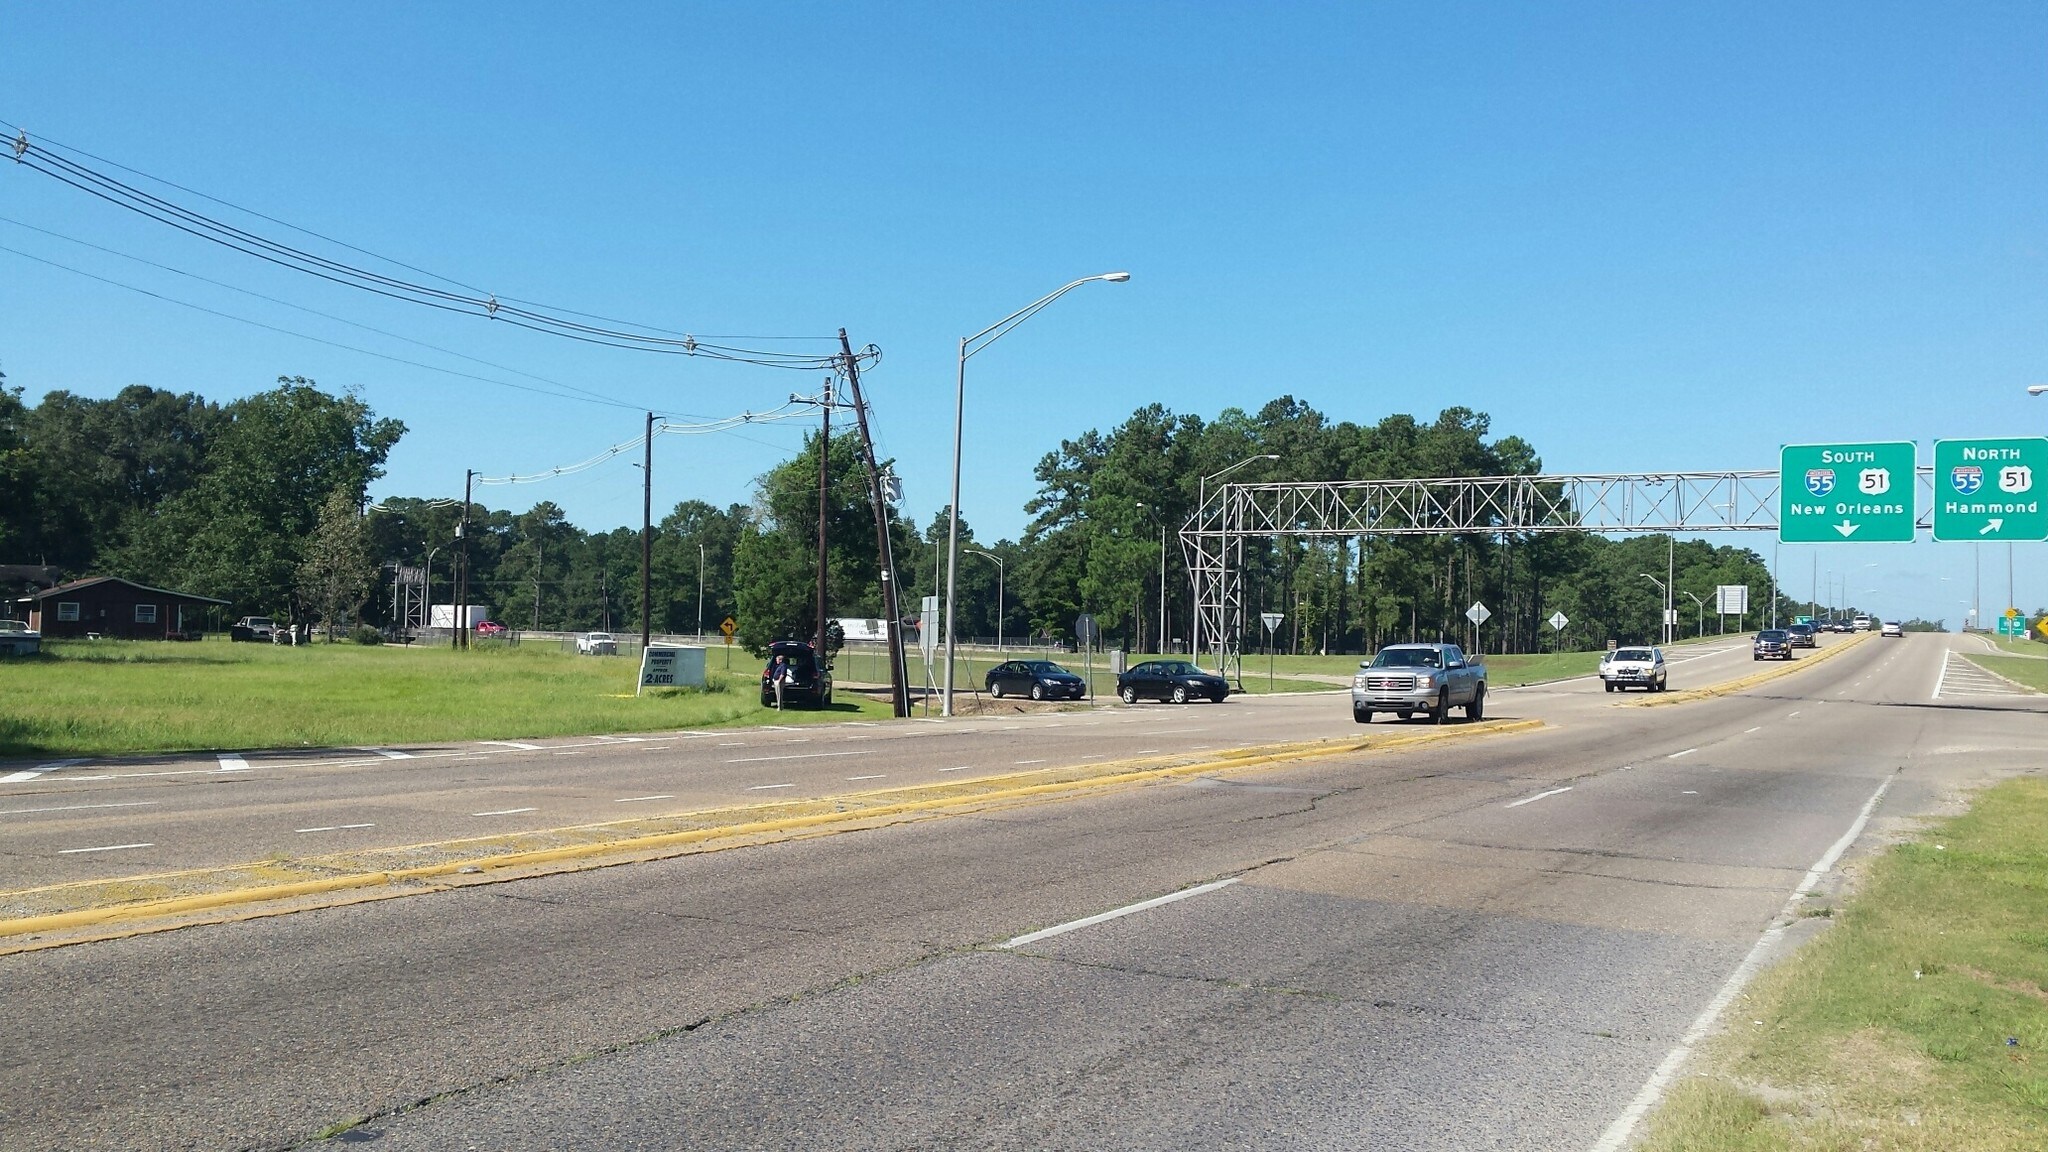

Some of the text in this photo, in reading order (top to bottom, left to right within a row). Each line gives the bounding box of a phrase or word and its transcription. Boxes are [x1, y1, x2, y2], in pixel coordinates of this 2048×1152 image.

[1822, 450, 1875, 463] SOUTH
[1963, 447, 2020, 460] NORTH
[1809, 476, 1833, 491] 55
[1865, 474, 1884, 488] 51
[1956, 474, 1981, 489] 55
[2006, 472, 2025, 486] 51
[1791, 503, 1904, 515] New Orleans
[1946, 501, 2038, 514] Hammond
